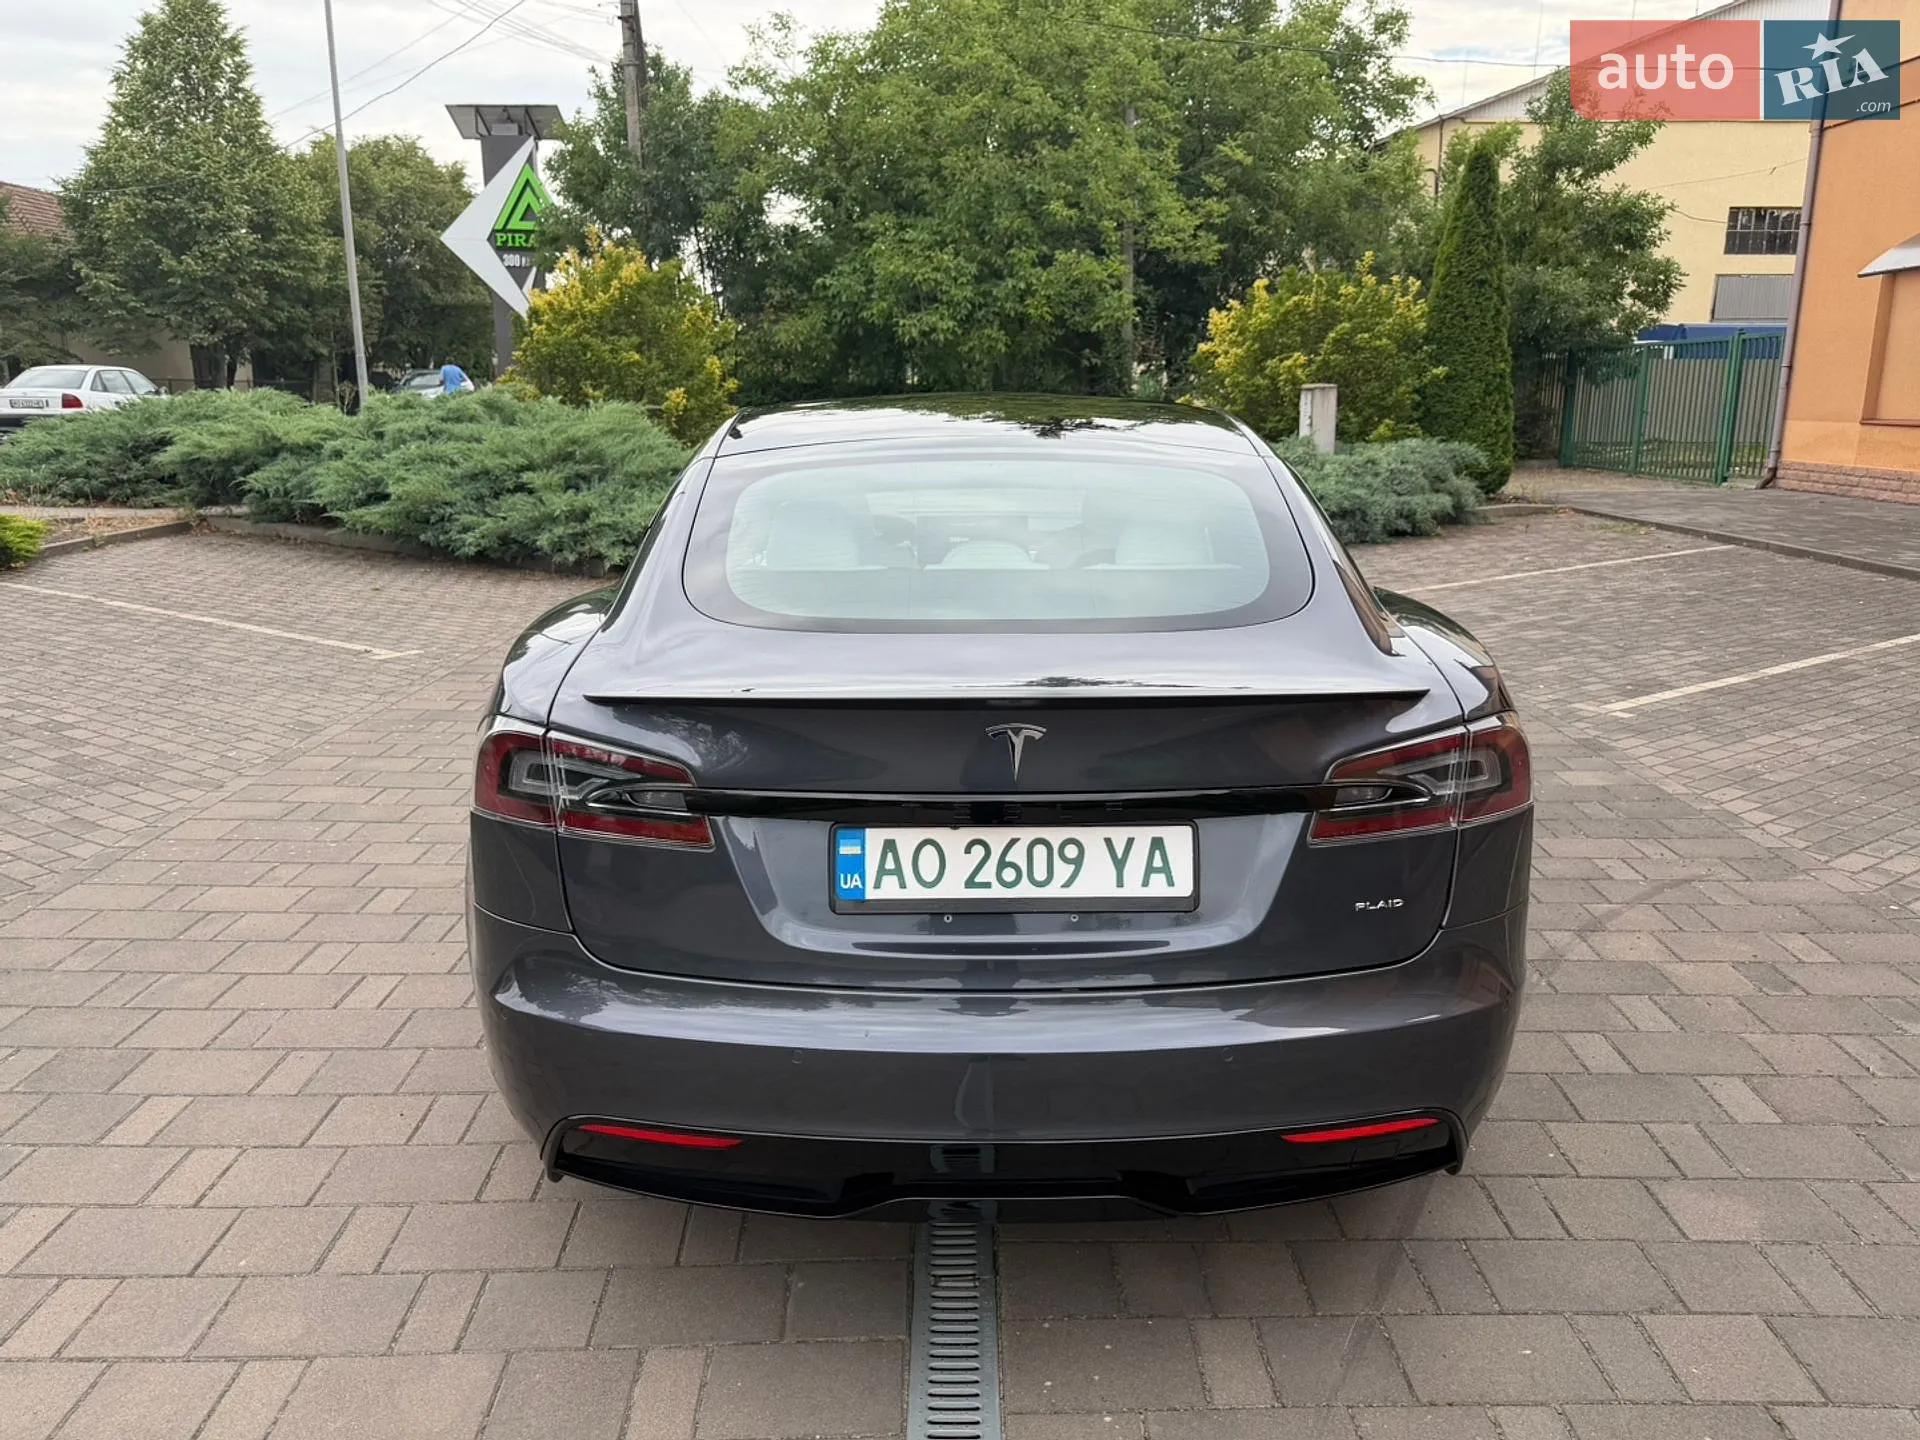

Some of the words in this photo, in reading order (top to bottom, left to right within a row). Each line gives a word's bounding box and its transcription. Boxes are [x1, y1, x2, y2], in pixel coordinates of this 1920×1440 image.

[872, 837, 947, 890] AO
[963, 836, 1086, 889] 2609
[1103, 836, 1176, 888] YA
[840, 873, 863, 890] UA
[1355, 898, 1404, 912] PLAID
